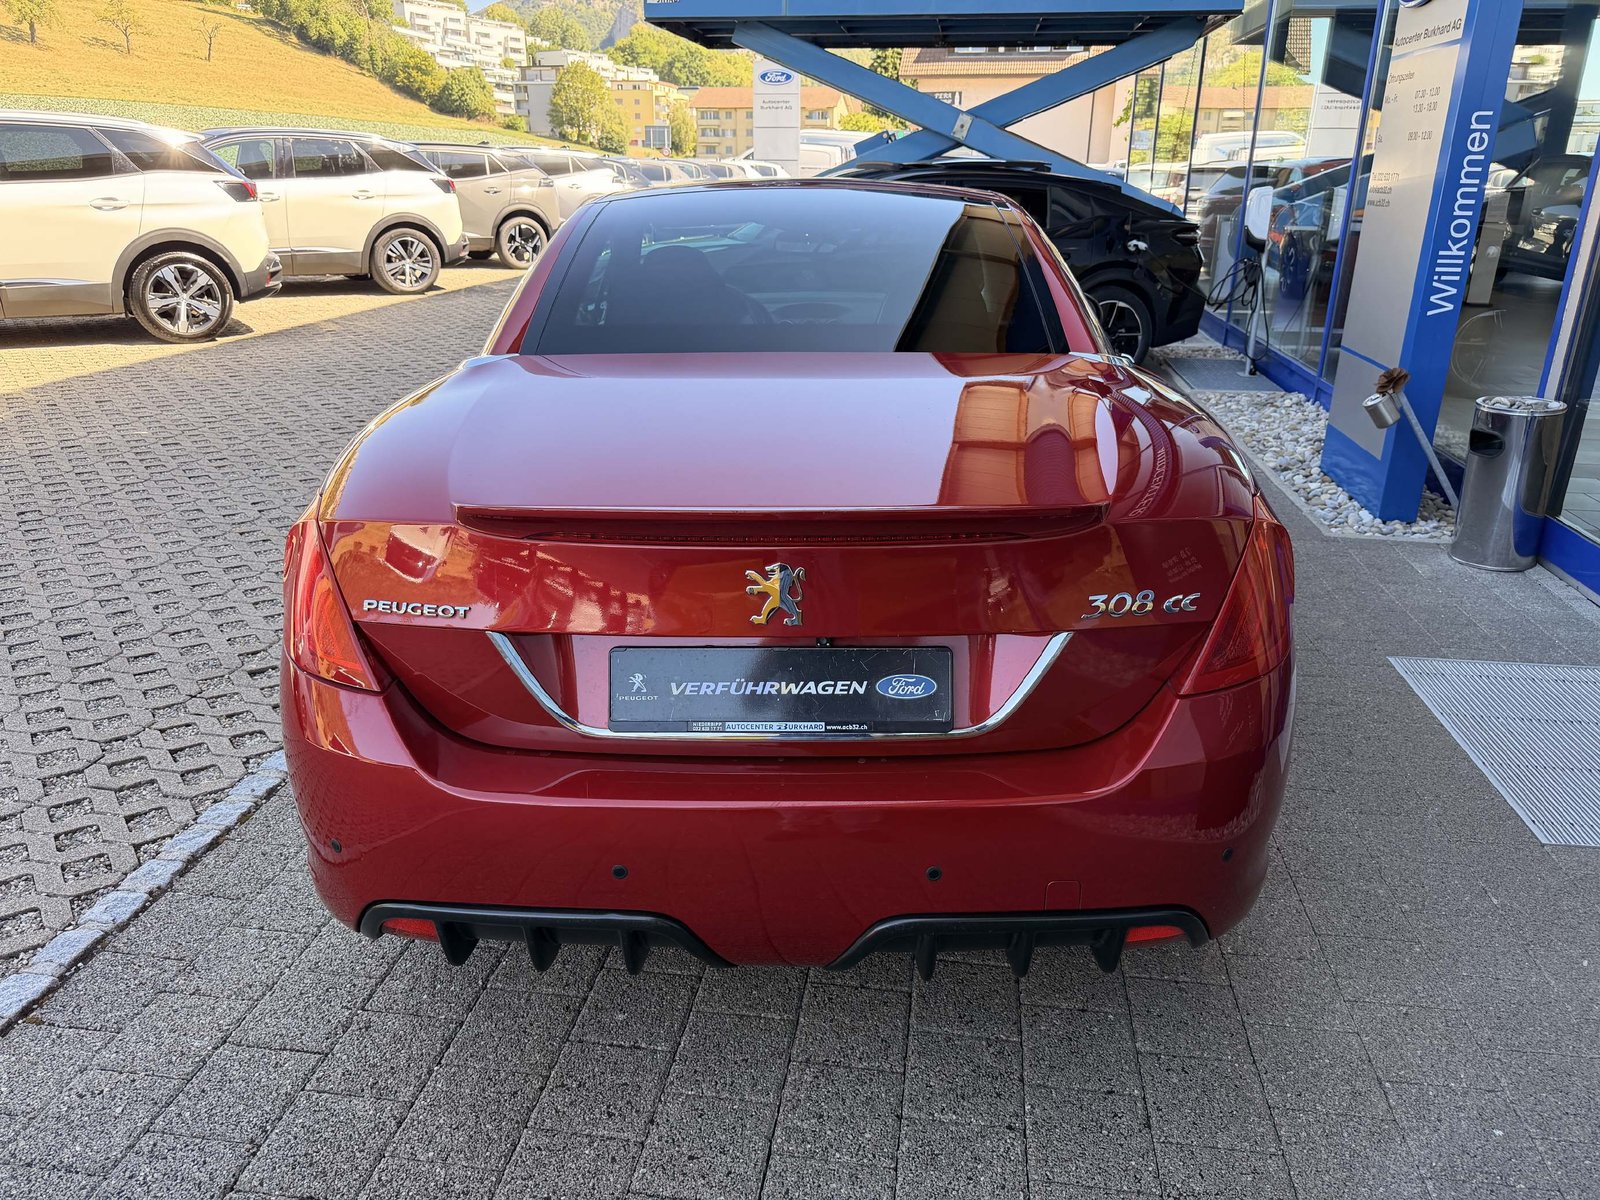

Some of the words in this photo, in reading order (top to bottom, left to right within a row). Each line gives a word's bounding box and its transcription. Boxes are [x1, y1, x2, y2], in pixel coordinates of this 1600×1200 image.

[1394, 31, 1423, 47] Autocenter
[1423, 22, 1452, 40] Burkhard
[1451, 18, 1462, 32] AG
[1426, 110, 1494, 316] Willkommen
[363, 599, 471, 619] PEUGEOT
[1081, 589, 1155, 620] 308
[670, 678, 868, 696] VERFÜHRWAGEN
[726, 723, 774, 731] AUTOCENTER
